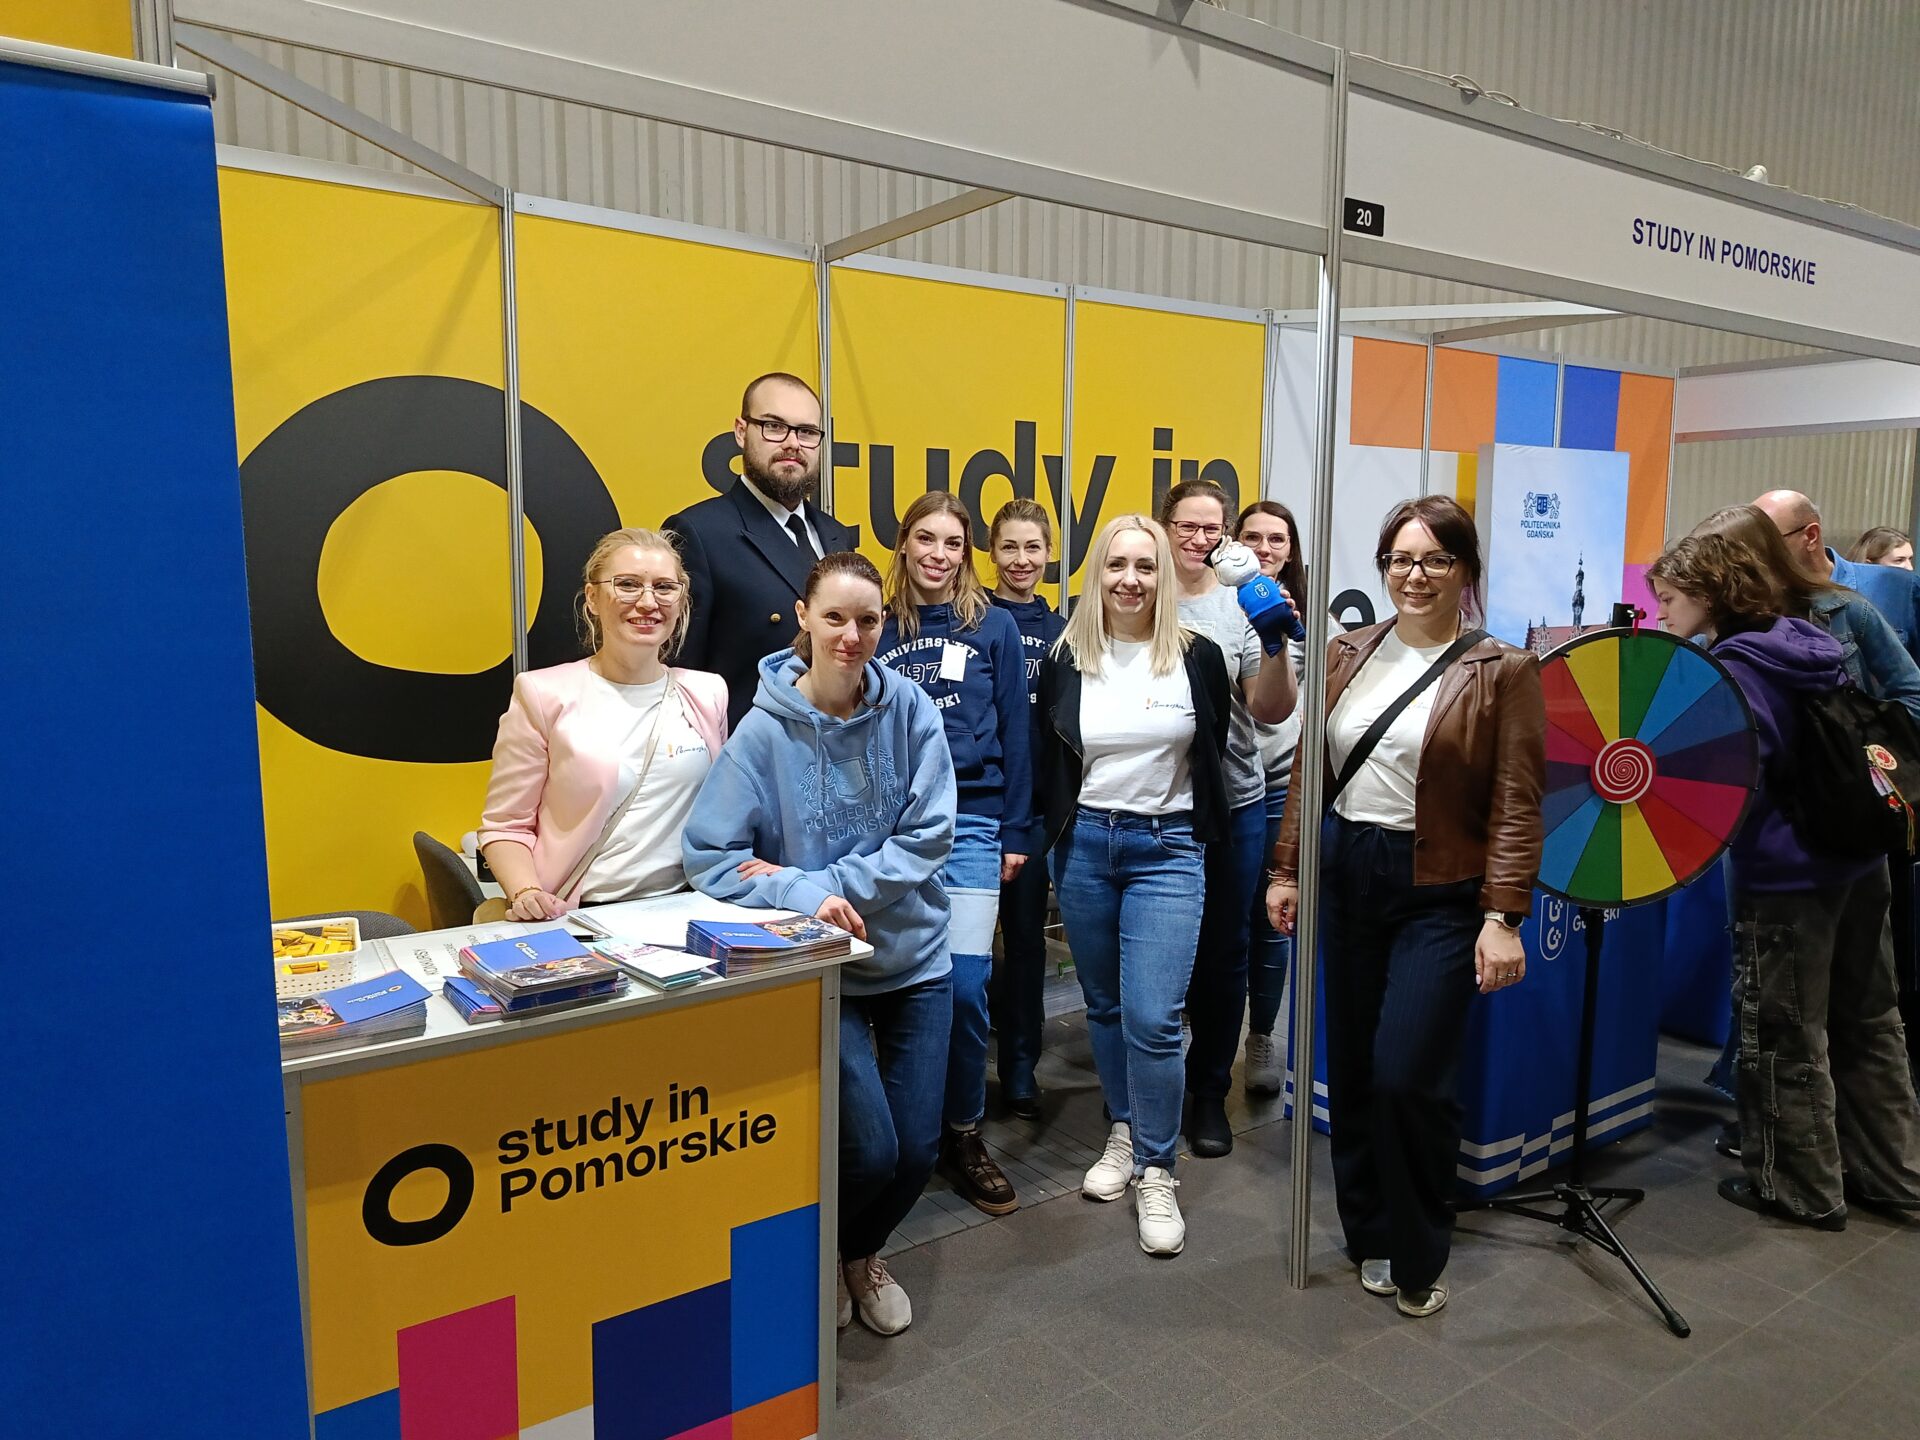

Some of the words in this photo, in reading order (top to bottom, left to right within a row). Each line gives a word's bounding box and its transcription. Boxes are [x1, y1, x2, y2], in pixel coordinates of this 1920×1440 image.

[1356, 208, 1372, 227] 20
[1632, 217, 1695, 256] STUDY
[1698, 234, 1716, 262] IN
[1720, 239, 1817, 286] POMORSKIE
[1520, 520, 1561, 529] POLITECHNIKA
[895, 661, 943, 684] 197
[497, 1096, 655, 1165] study
[668, 1082, 709, 1124] in
[500, 1109, 778, 1214] Pomorskie
